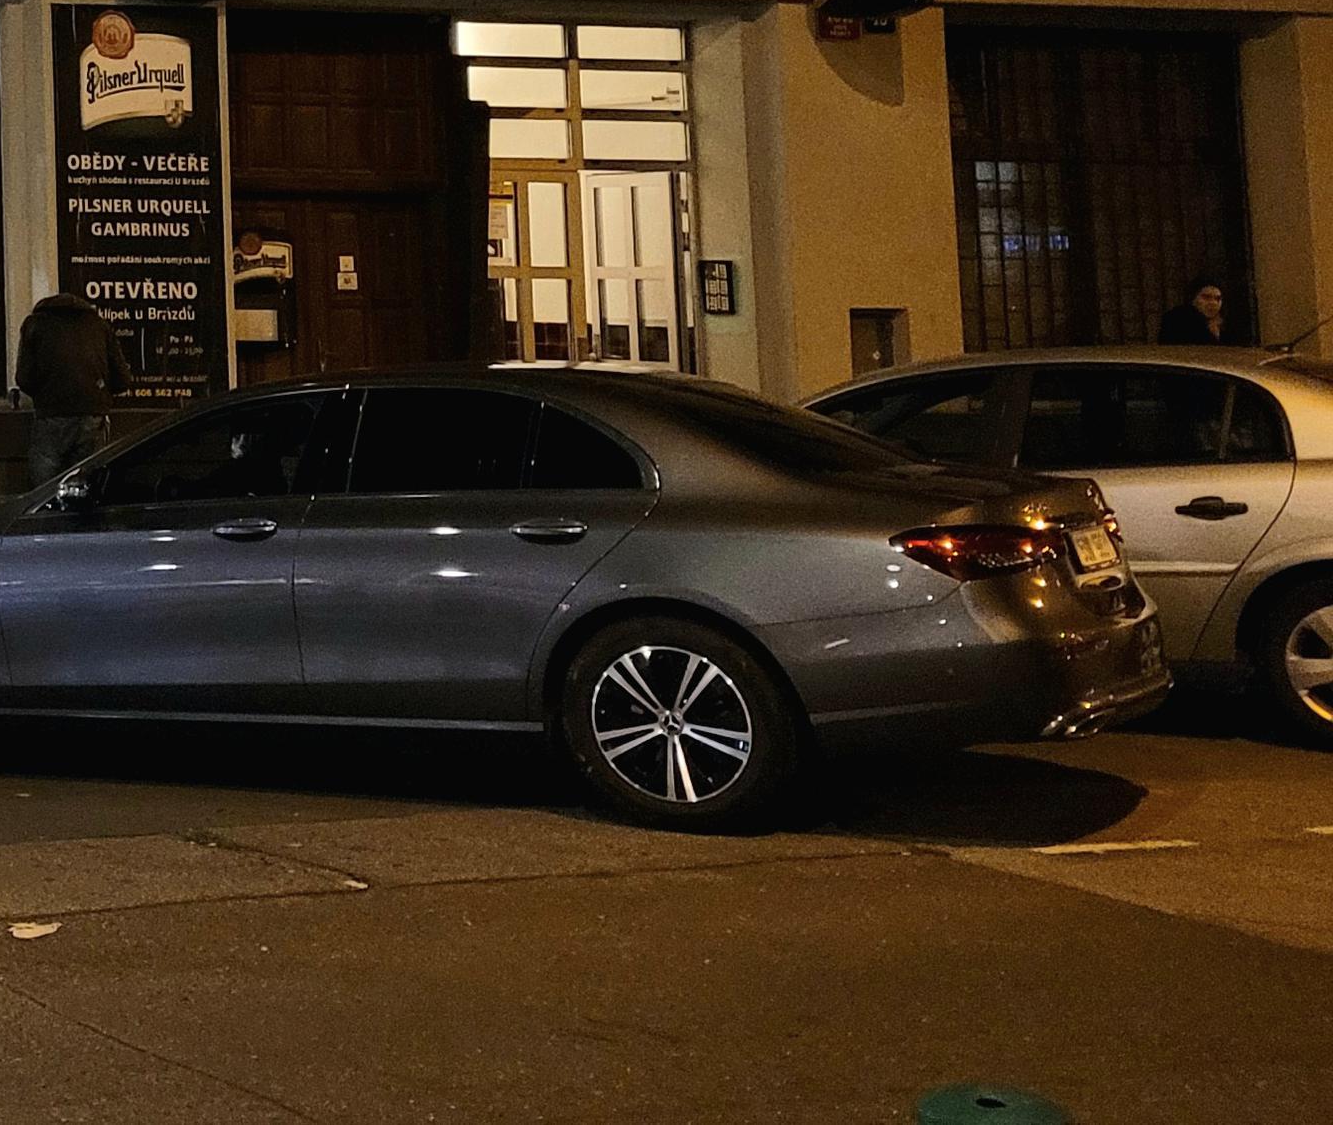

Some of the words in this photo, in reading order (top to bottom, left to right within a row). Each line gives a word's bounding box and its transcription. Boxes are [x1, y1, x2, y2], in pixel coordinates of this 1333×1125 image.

[86, 61, 137, 104] Pilsner
[135, 60, 186, 93] Urquell
[67, 151, 126, 171] OBĚDY
[142, 152, 210, 172] VEČEŘE
[68, 198, 133, 213] PILSNER
[137, 199, 211, 217] URQUELL
[91, 222, 190, 237] GAMBRINUS
[86, 277, 198, 300] OTEVŘENO
[91, 305, 131, 323] klípek
[134, 309, 143, 320] u
